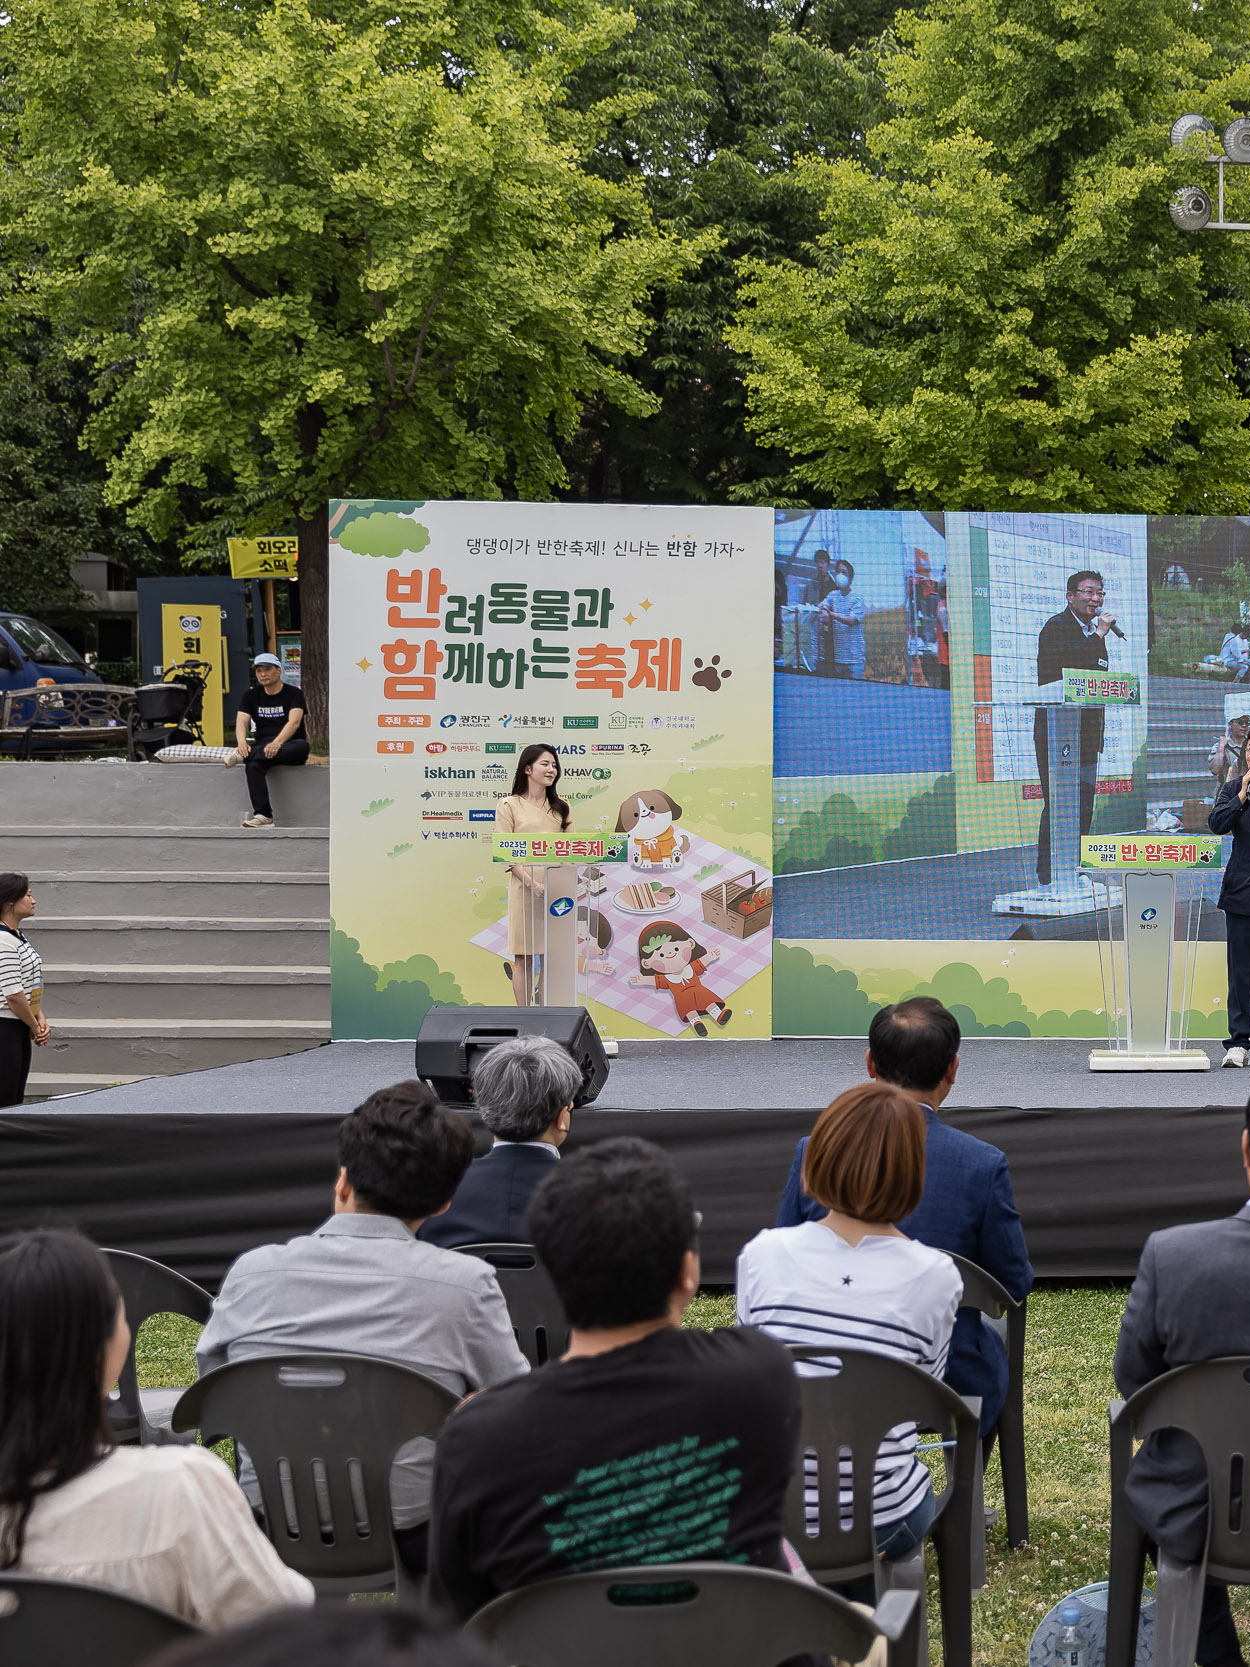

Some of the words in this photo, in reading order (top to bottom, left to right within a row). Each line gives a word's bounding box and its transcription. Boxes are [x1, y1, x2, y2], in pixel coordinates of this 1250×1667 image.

[466, 537, 531, 556] 댕댕이가
[537, 538, 606, 558] 반한축제!
[613, 540, 660, 558] 신나는
[666, 540, 698, 558] 반함
[704, 541, 746, 559] 가자~
[386, 568, 614, 636] 반려동물과
[1068, 678, 1086, 687] 2023년
[460, 715, 491, 724] 광진구
[514, 716, 554, 726] 서울특별시
[611, 716, 624, 724] KU
[386, 742, 404, 752] 후원
[429, 744, 444, 752] 하림
[424, 766, 476, 779] iskhan
[432, 790, 446, 798] VIP
[576, 792, 592, 800] Core
[434, 831, 478, 840] 대한수의사회
[499, 840, 527, 848] 2023년
[1088, 844, 1116, 853] 2023년
[512, 849, 527, 858] 광진
[1100, 852, 1116, 862] 광진
